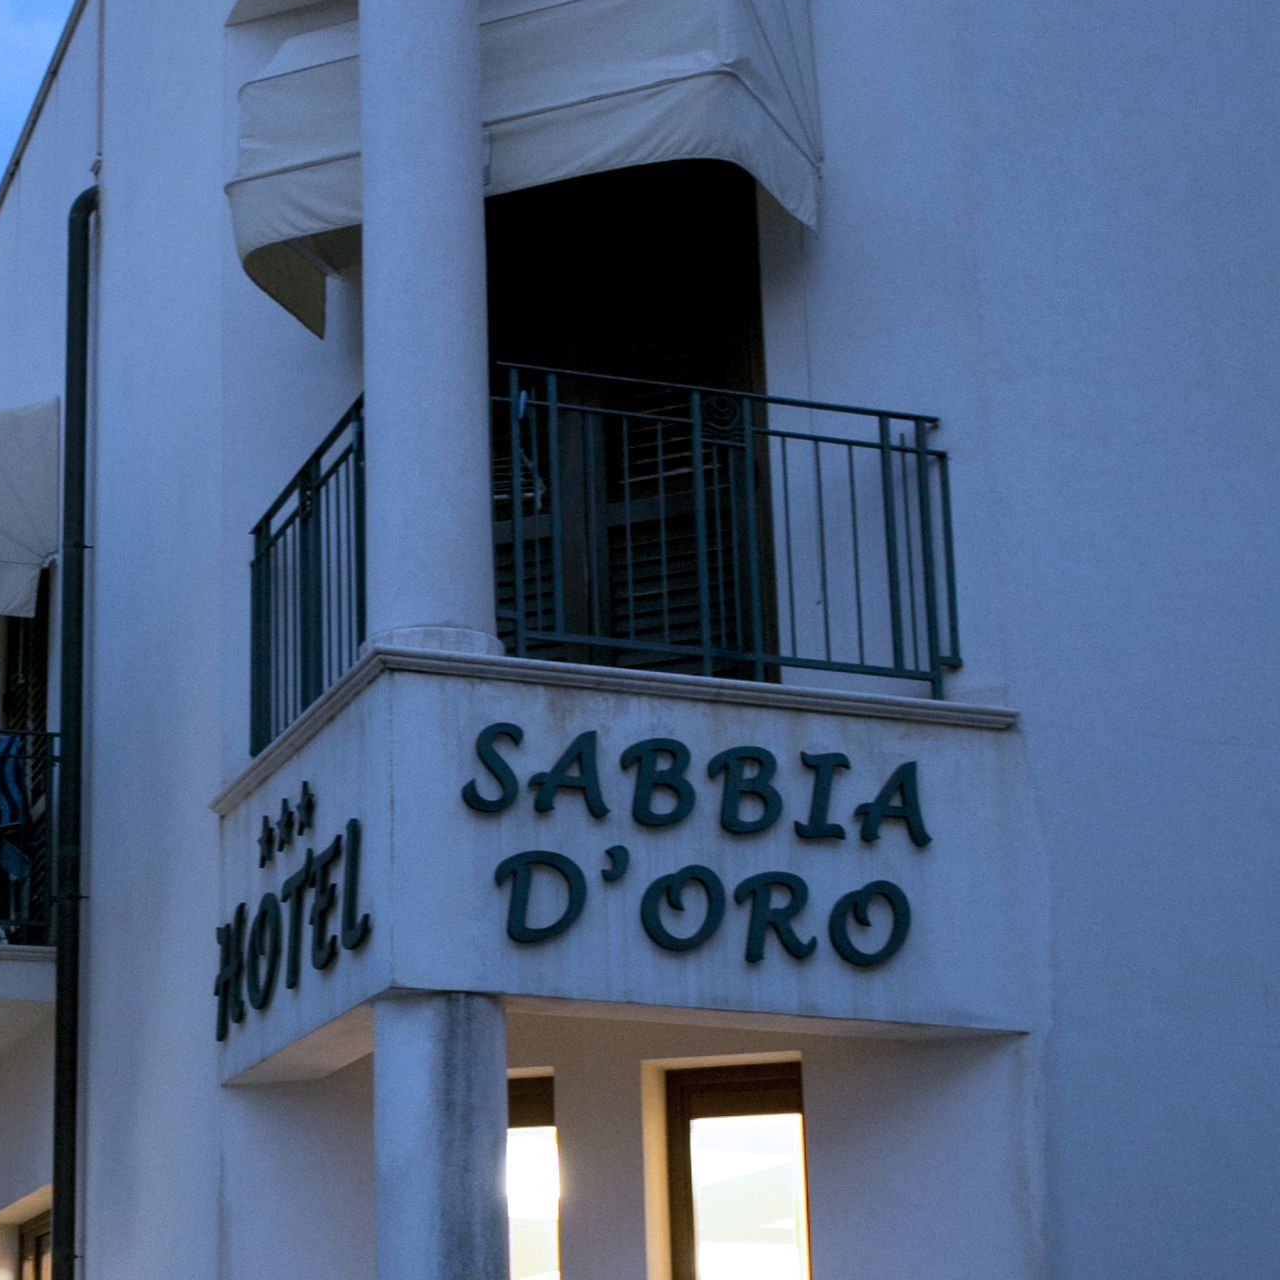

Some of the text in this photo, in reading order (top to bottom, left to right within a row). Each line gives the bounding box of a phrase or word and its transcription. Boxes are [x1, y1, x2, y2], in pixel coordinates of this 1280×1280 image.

[462, 722, 932, 847] SABBIA
[213, 818, 371, 1042] HOTEL
[494, 844, 912, 967] D'ORO
